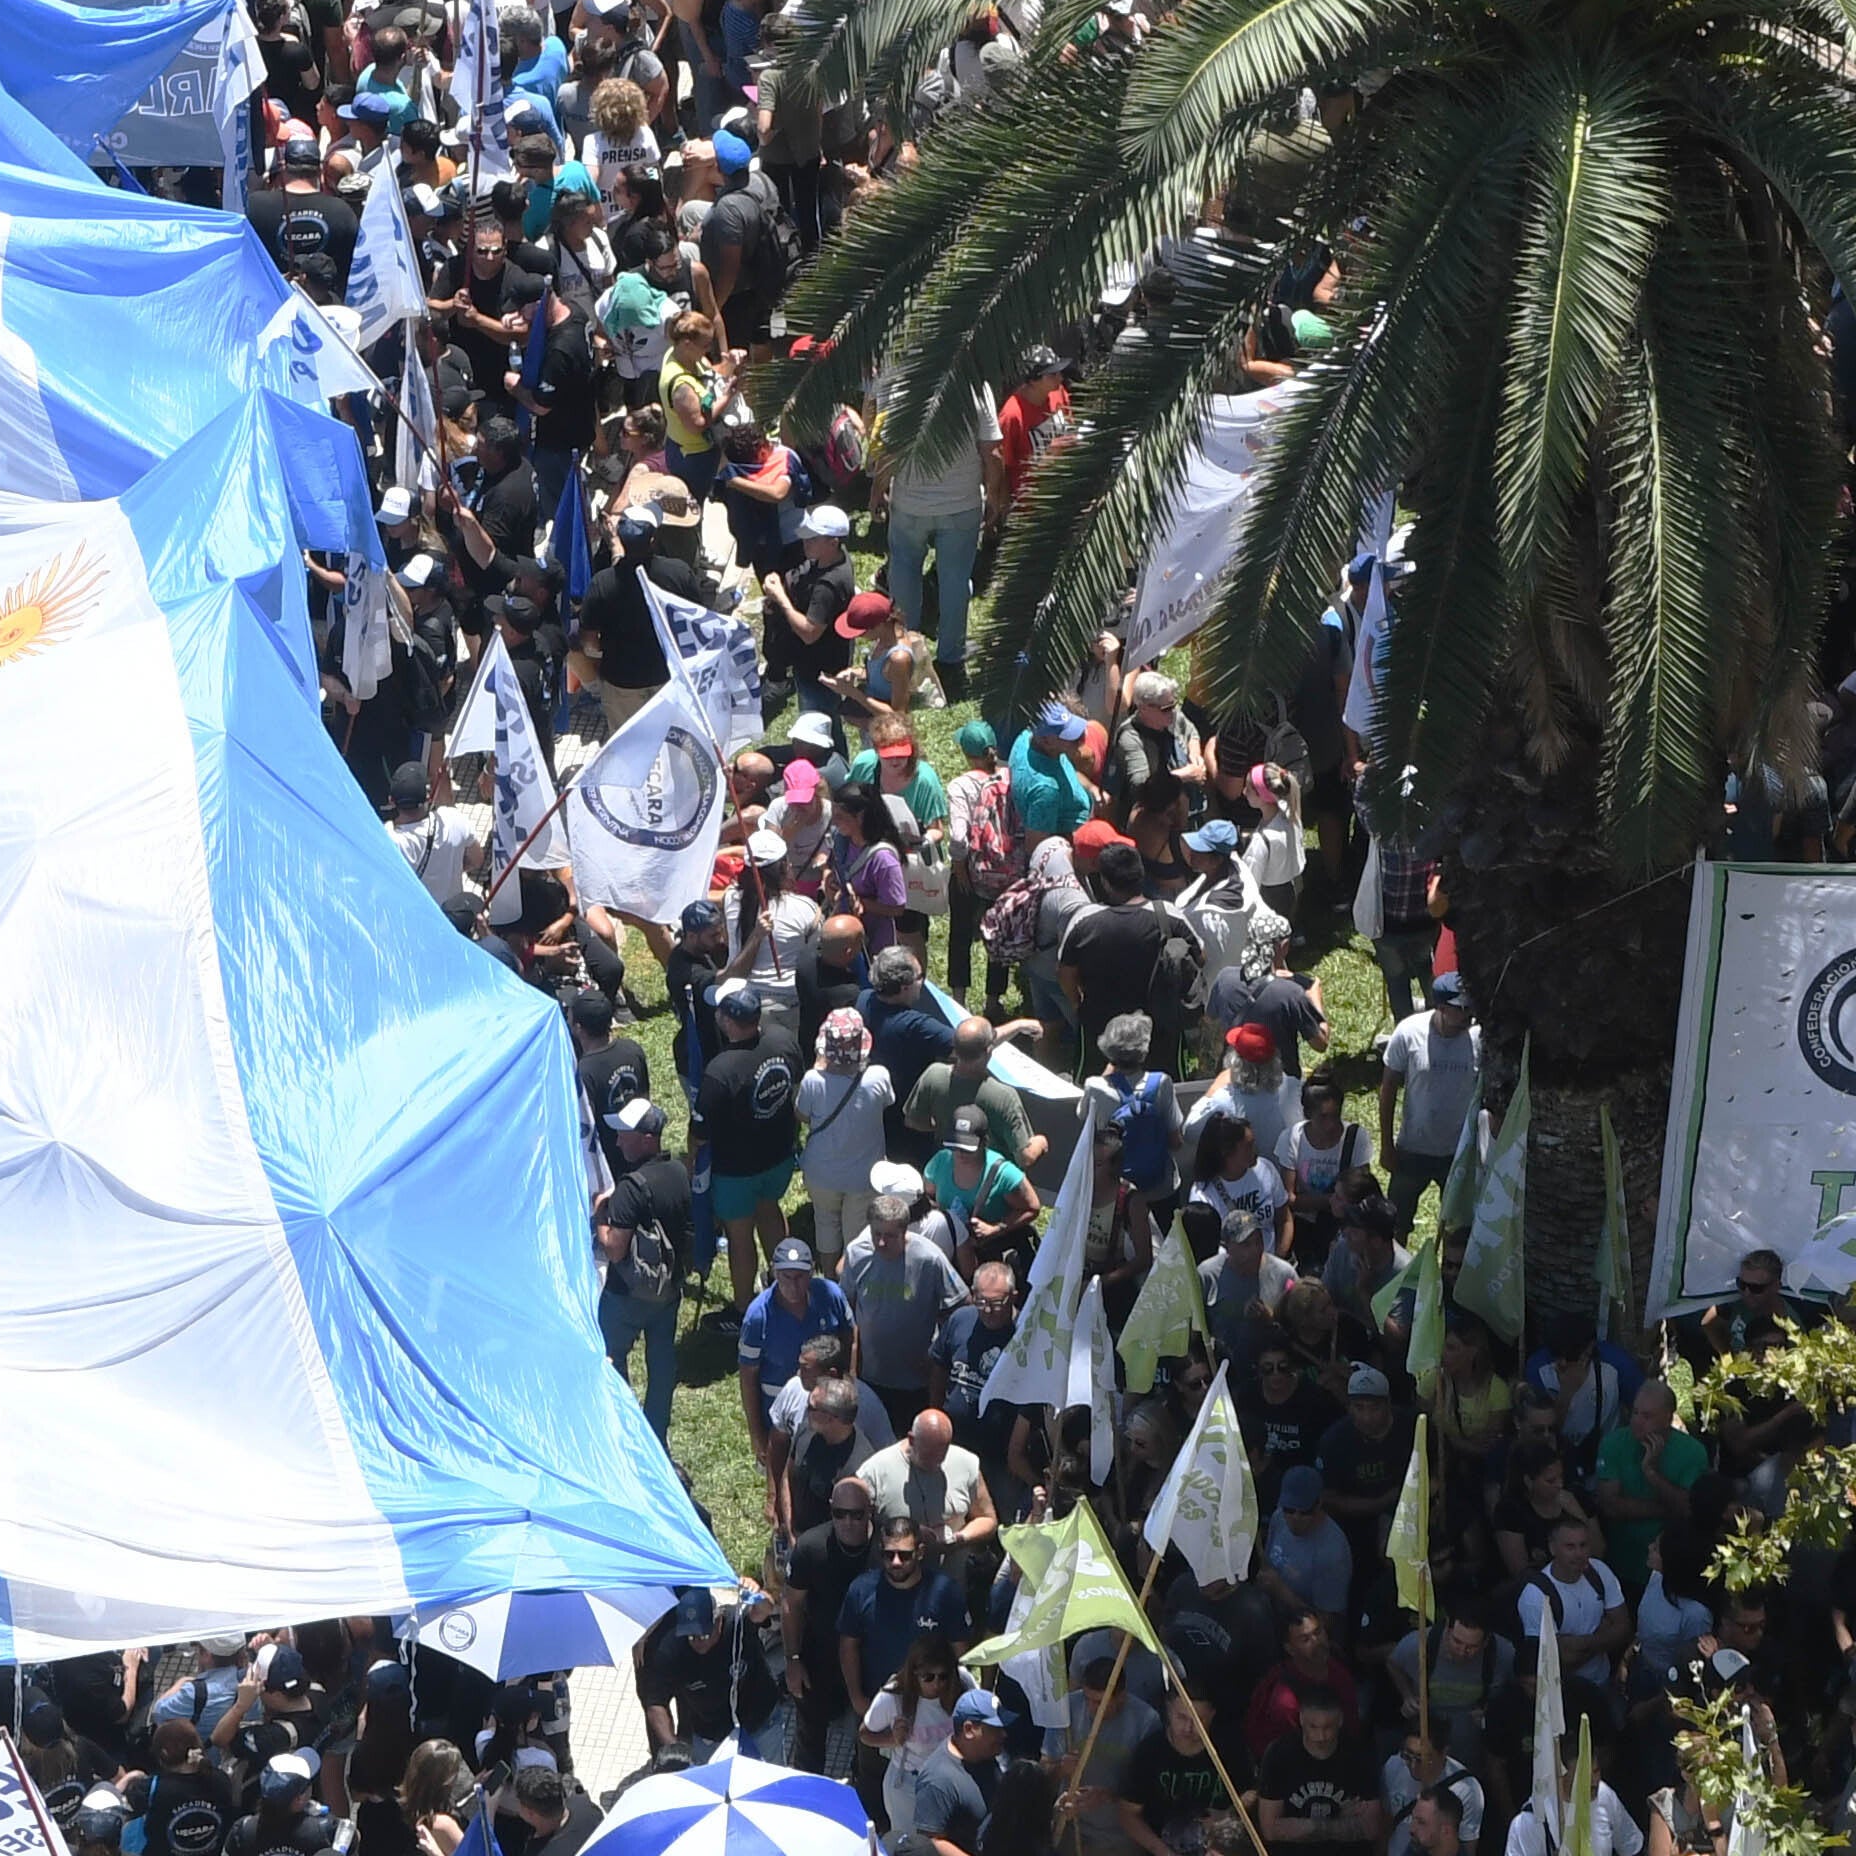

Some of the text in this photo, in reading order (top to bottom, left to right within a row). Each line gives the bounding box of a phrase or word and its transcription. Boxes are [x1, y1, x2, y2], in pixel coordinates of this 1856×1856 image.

[601, 147, 648, 164] PRENSA
[282, 209, 324, 221] SCADURA
[644, 752, 664, 829] ECARA
[753, 1056, 785, 1080] SACADURA
[1257, 1207, 1273, 1222] SB
[171, 1800, 218, 1813] SACADURA
[175, 1824, 216, 1837] UECARA
